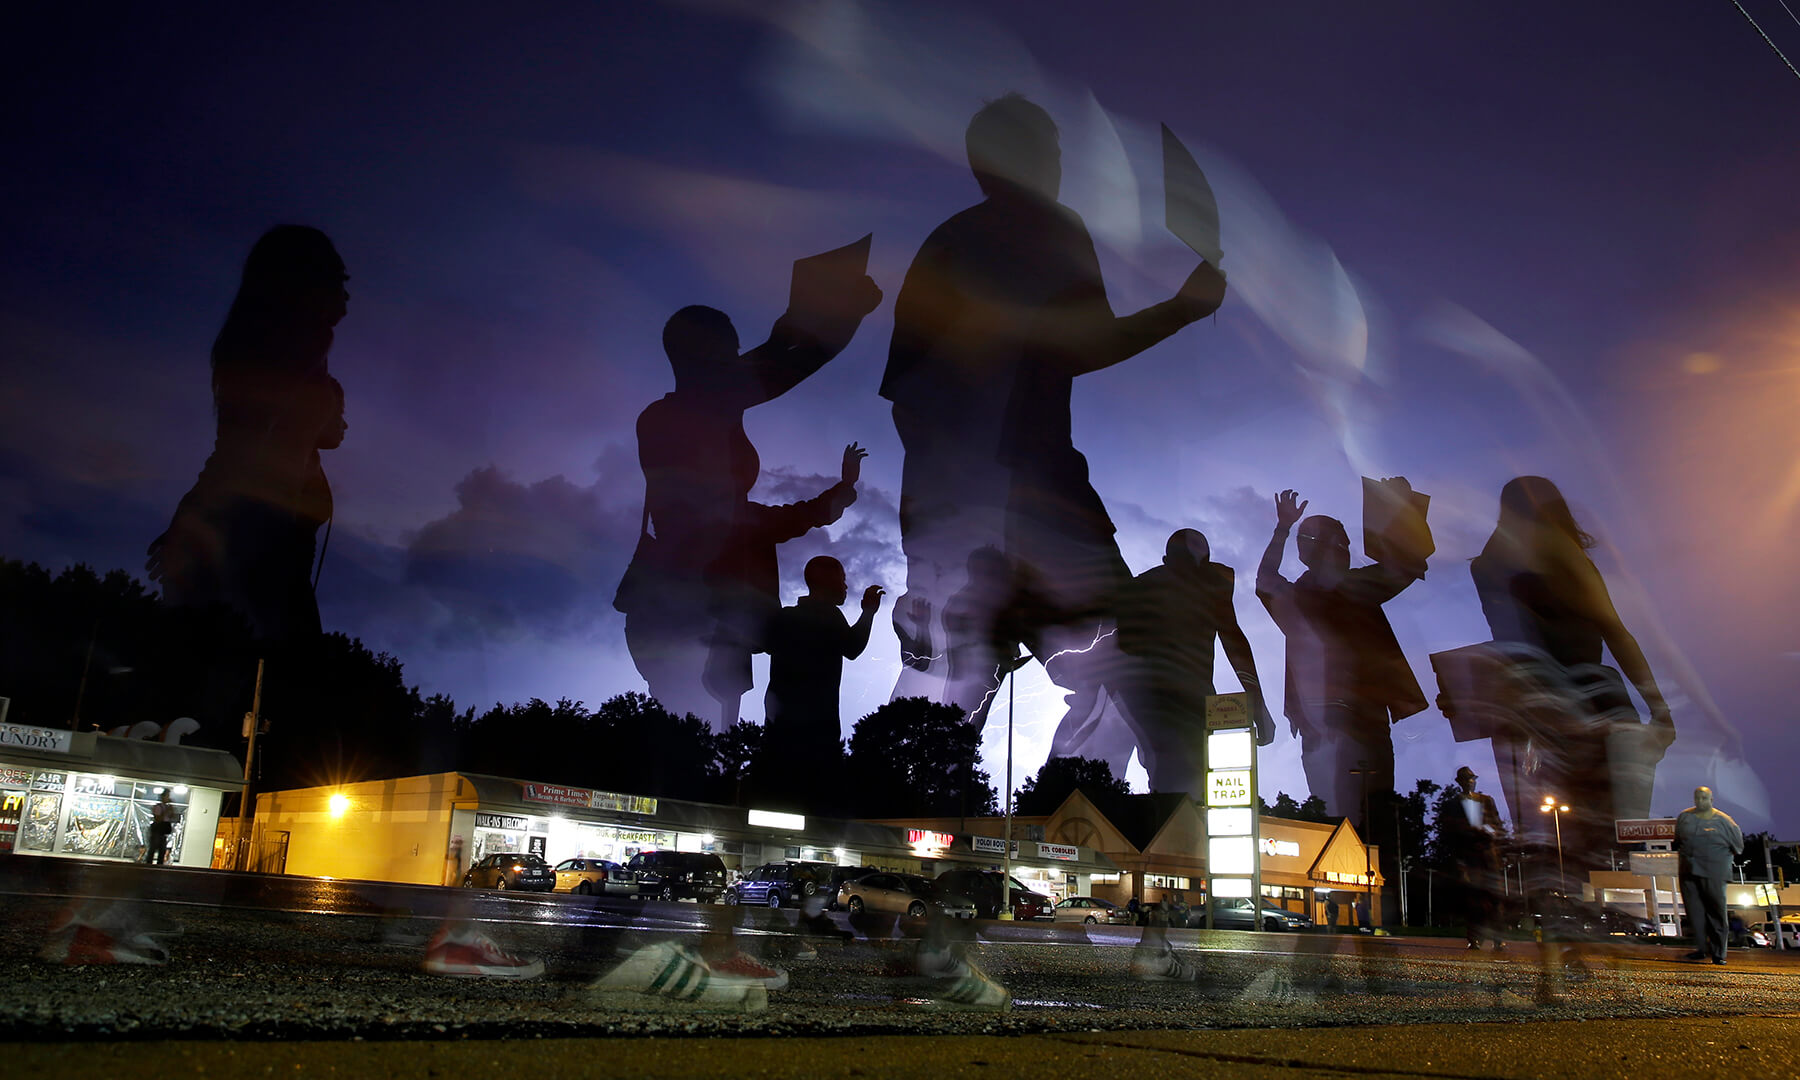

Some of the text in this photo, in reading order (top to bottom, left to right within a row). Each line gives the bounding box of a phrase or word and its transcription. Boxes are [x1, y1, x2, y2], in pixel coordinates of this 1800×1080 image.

[1216, 777, 1244, 787] NAIL
[543, 785, 585, 799] Prime Time
[1213, 789, 1246, 800] TRAP
[1621, 824, 1655, 837] FAMILY
